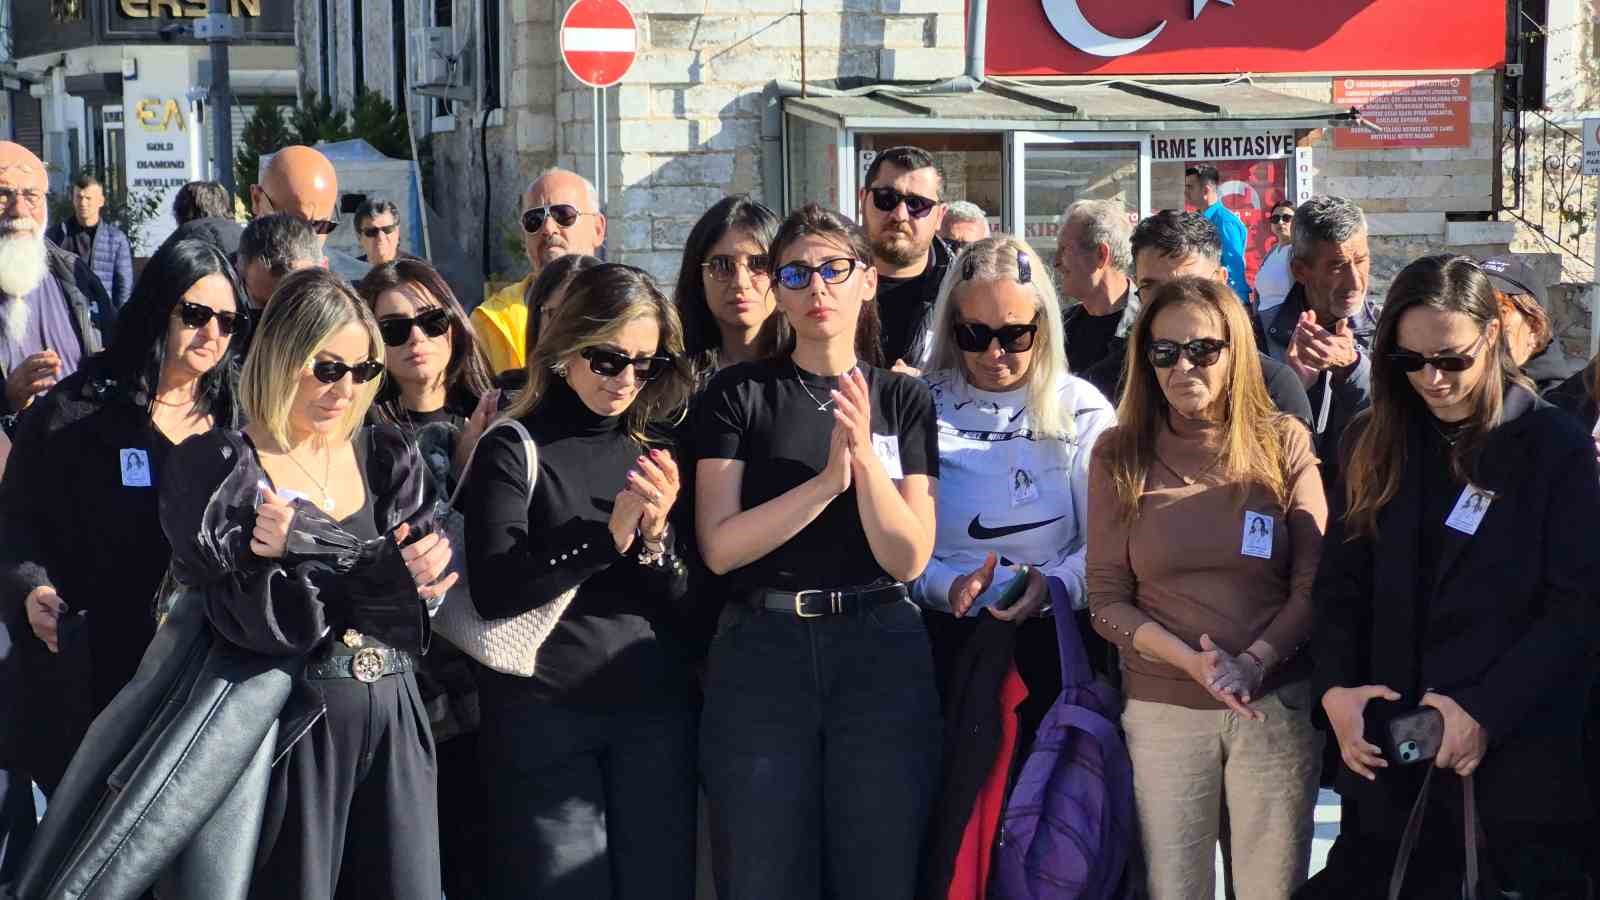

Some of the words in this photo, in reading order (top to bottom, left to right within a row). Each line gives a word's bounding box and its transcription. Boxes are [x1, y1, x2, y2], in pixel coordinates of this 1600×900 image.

[120, 0, 261, 17] ERSN
[146, 142, 174, 151] GOLD
[1203, 130, 1294, 158] KIRTASİYE
[136, 160, 185, 169] DIAMOND
